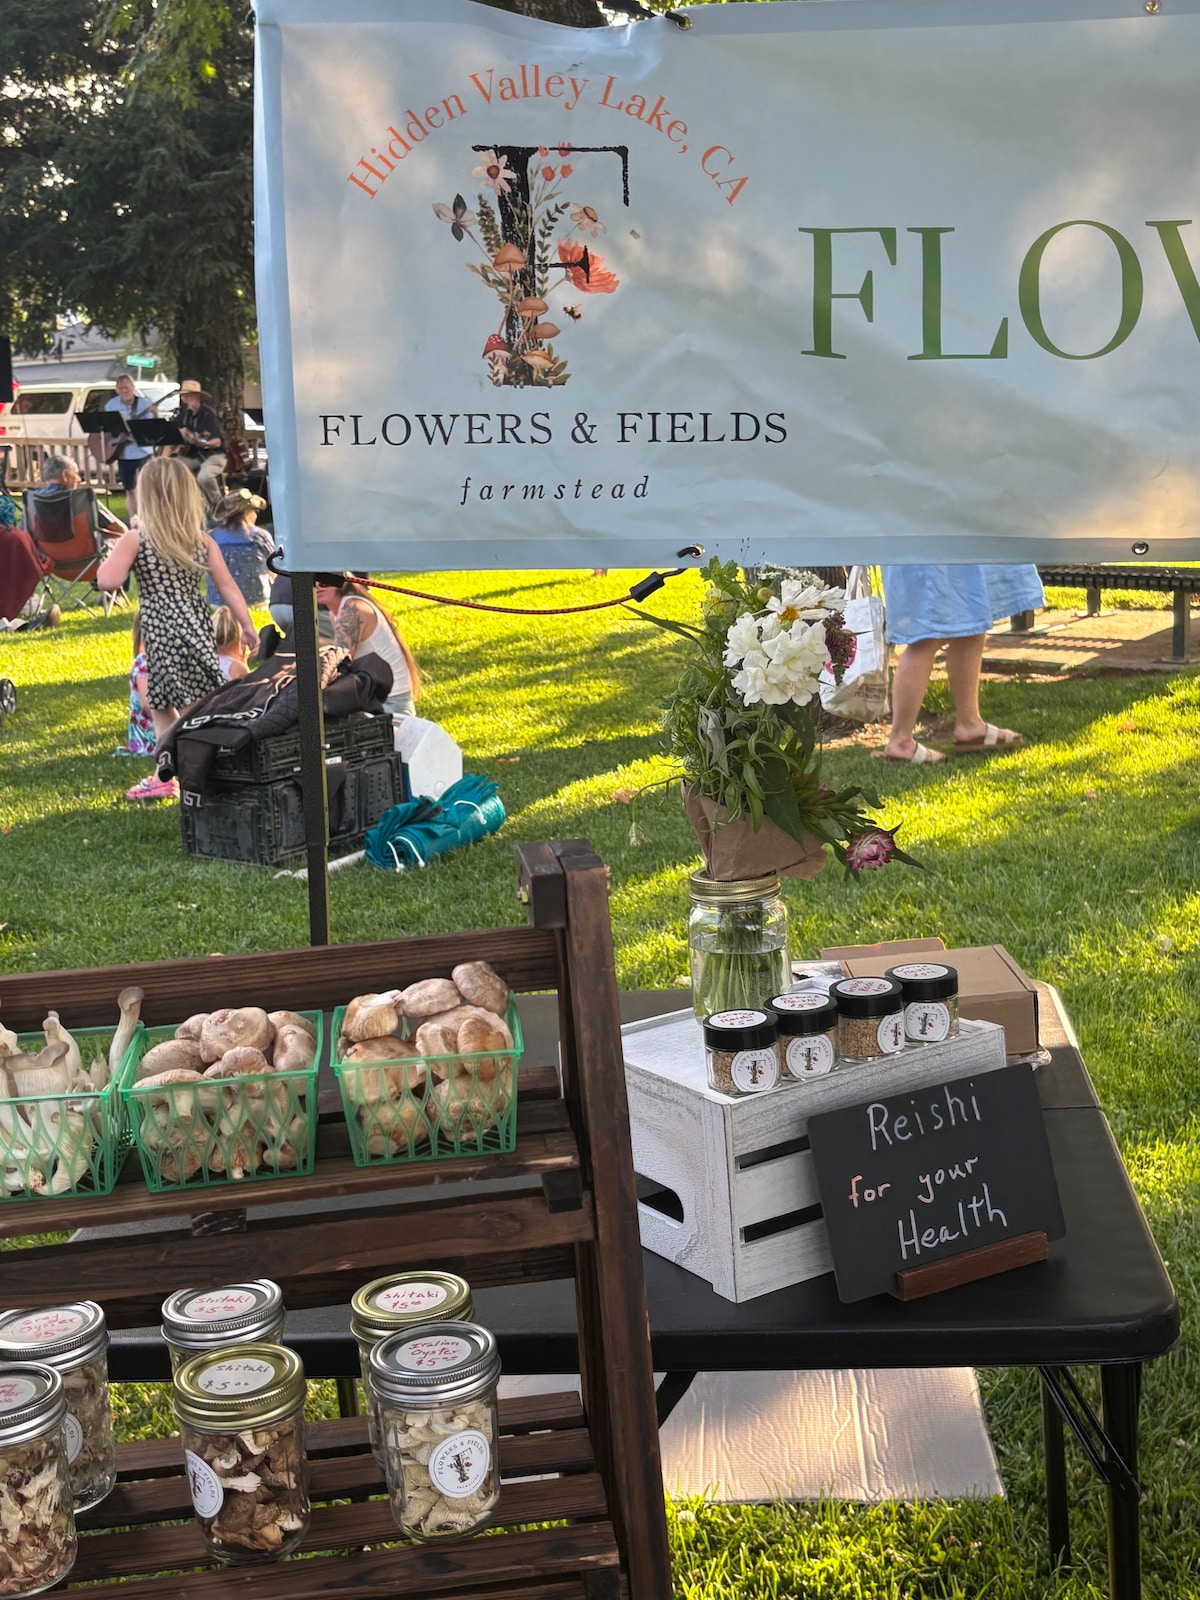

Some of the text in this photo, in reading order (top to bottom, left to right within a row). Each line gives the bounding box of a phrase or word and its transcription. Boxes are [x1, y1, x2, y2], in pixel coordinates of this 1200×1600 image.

[347, 65, 751, 207] Hidden Valley Lake, CA
[319, 411, 788, 446] FLOWERS & FIELDS
[460, 475, 650, 506] farmstead
[866, 1082, 982, 1150] Reishi
[848, 1156, 979, 1208] for your
[897, 1182, 1008, 1260] Health
[437, 1442, 458, 1476] FLOWERS
[467, 1439, 485, 1455] FIELDS
